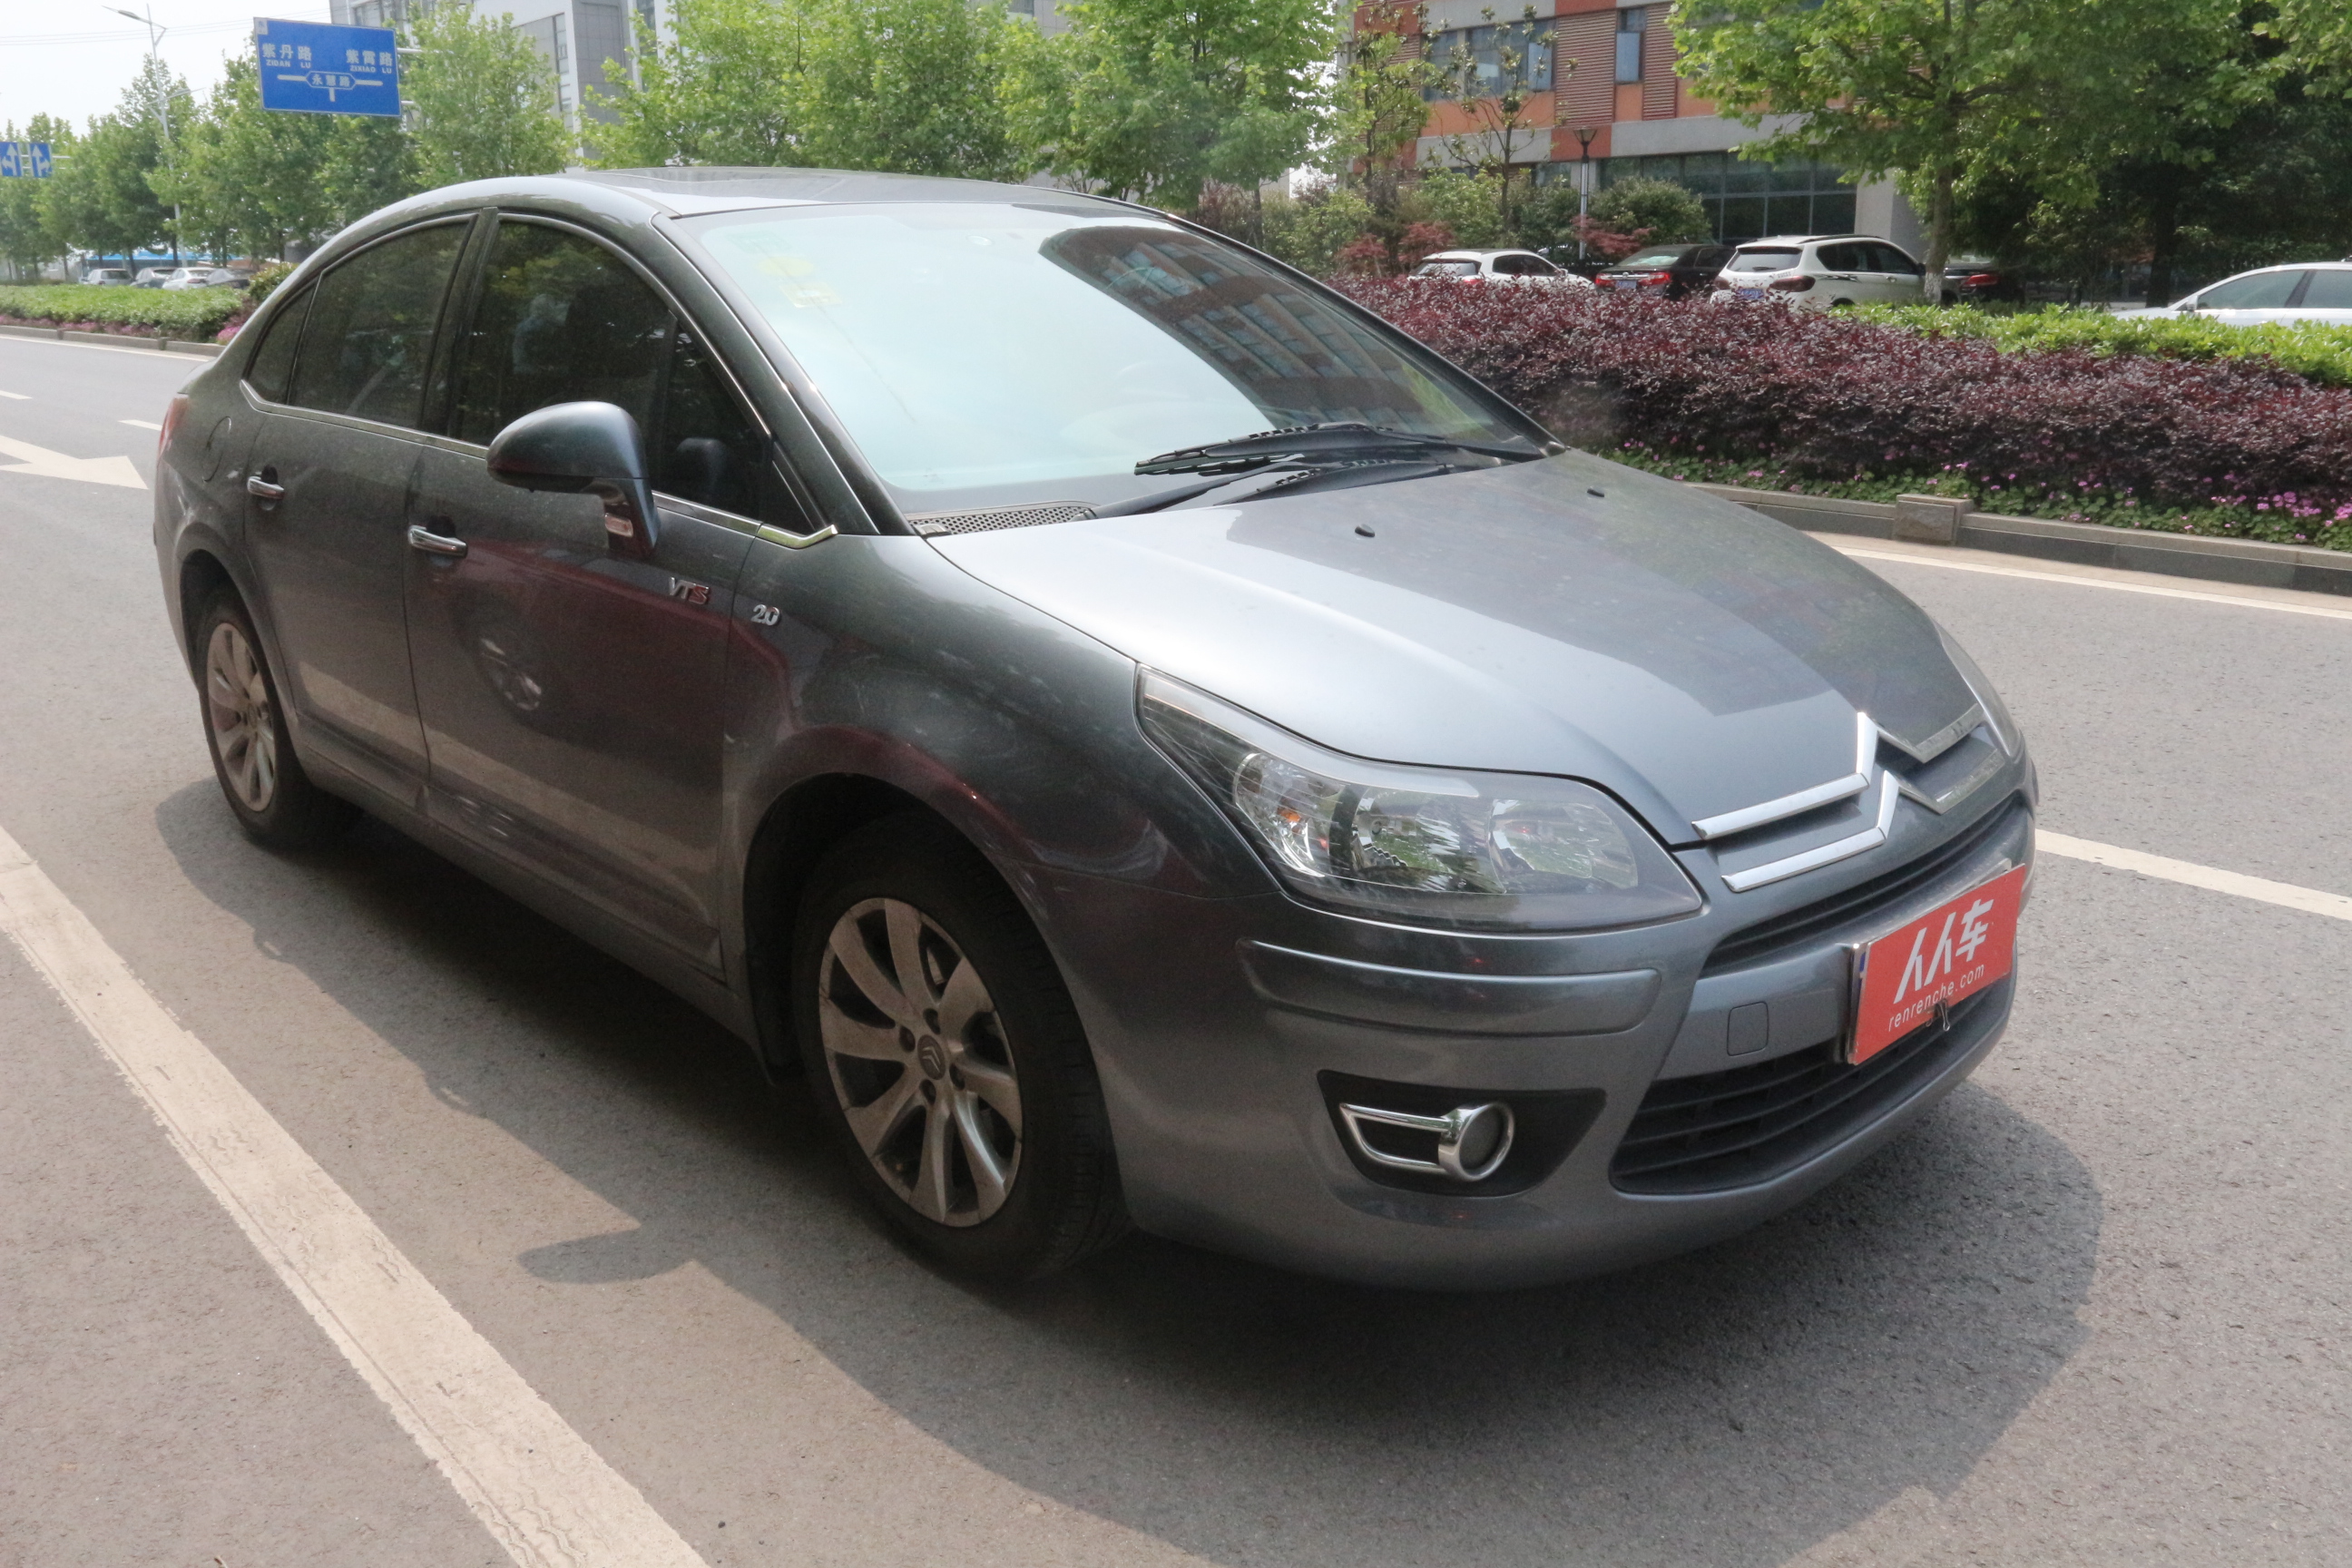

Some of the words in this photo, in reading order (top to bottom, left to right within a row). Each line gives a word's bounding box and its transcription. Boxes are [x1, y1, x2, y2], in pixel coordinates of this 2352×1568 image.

[262, 44, 312, 61] 紫丹路
[346, 49, 393, 66] 紫霄路
[266, 59, 291, 68] ZIDAN
[300, 61, 311, 69] LU
[349, 64, 377, 74] ZIXIAO
[668, 576, 710, 605] VTS
[1893, 898, 1994, 1004] 人人车
[1887, 964, 1984, 1032] renrenche.com
